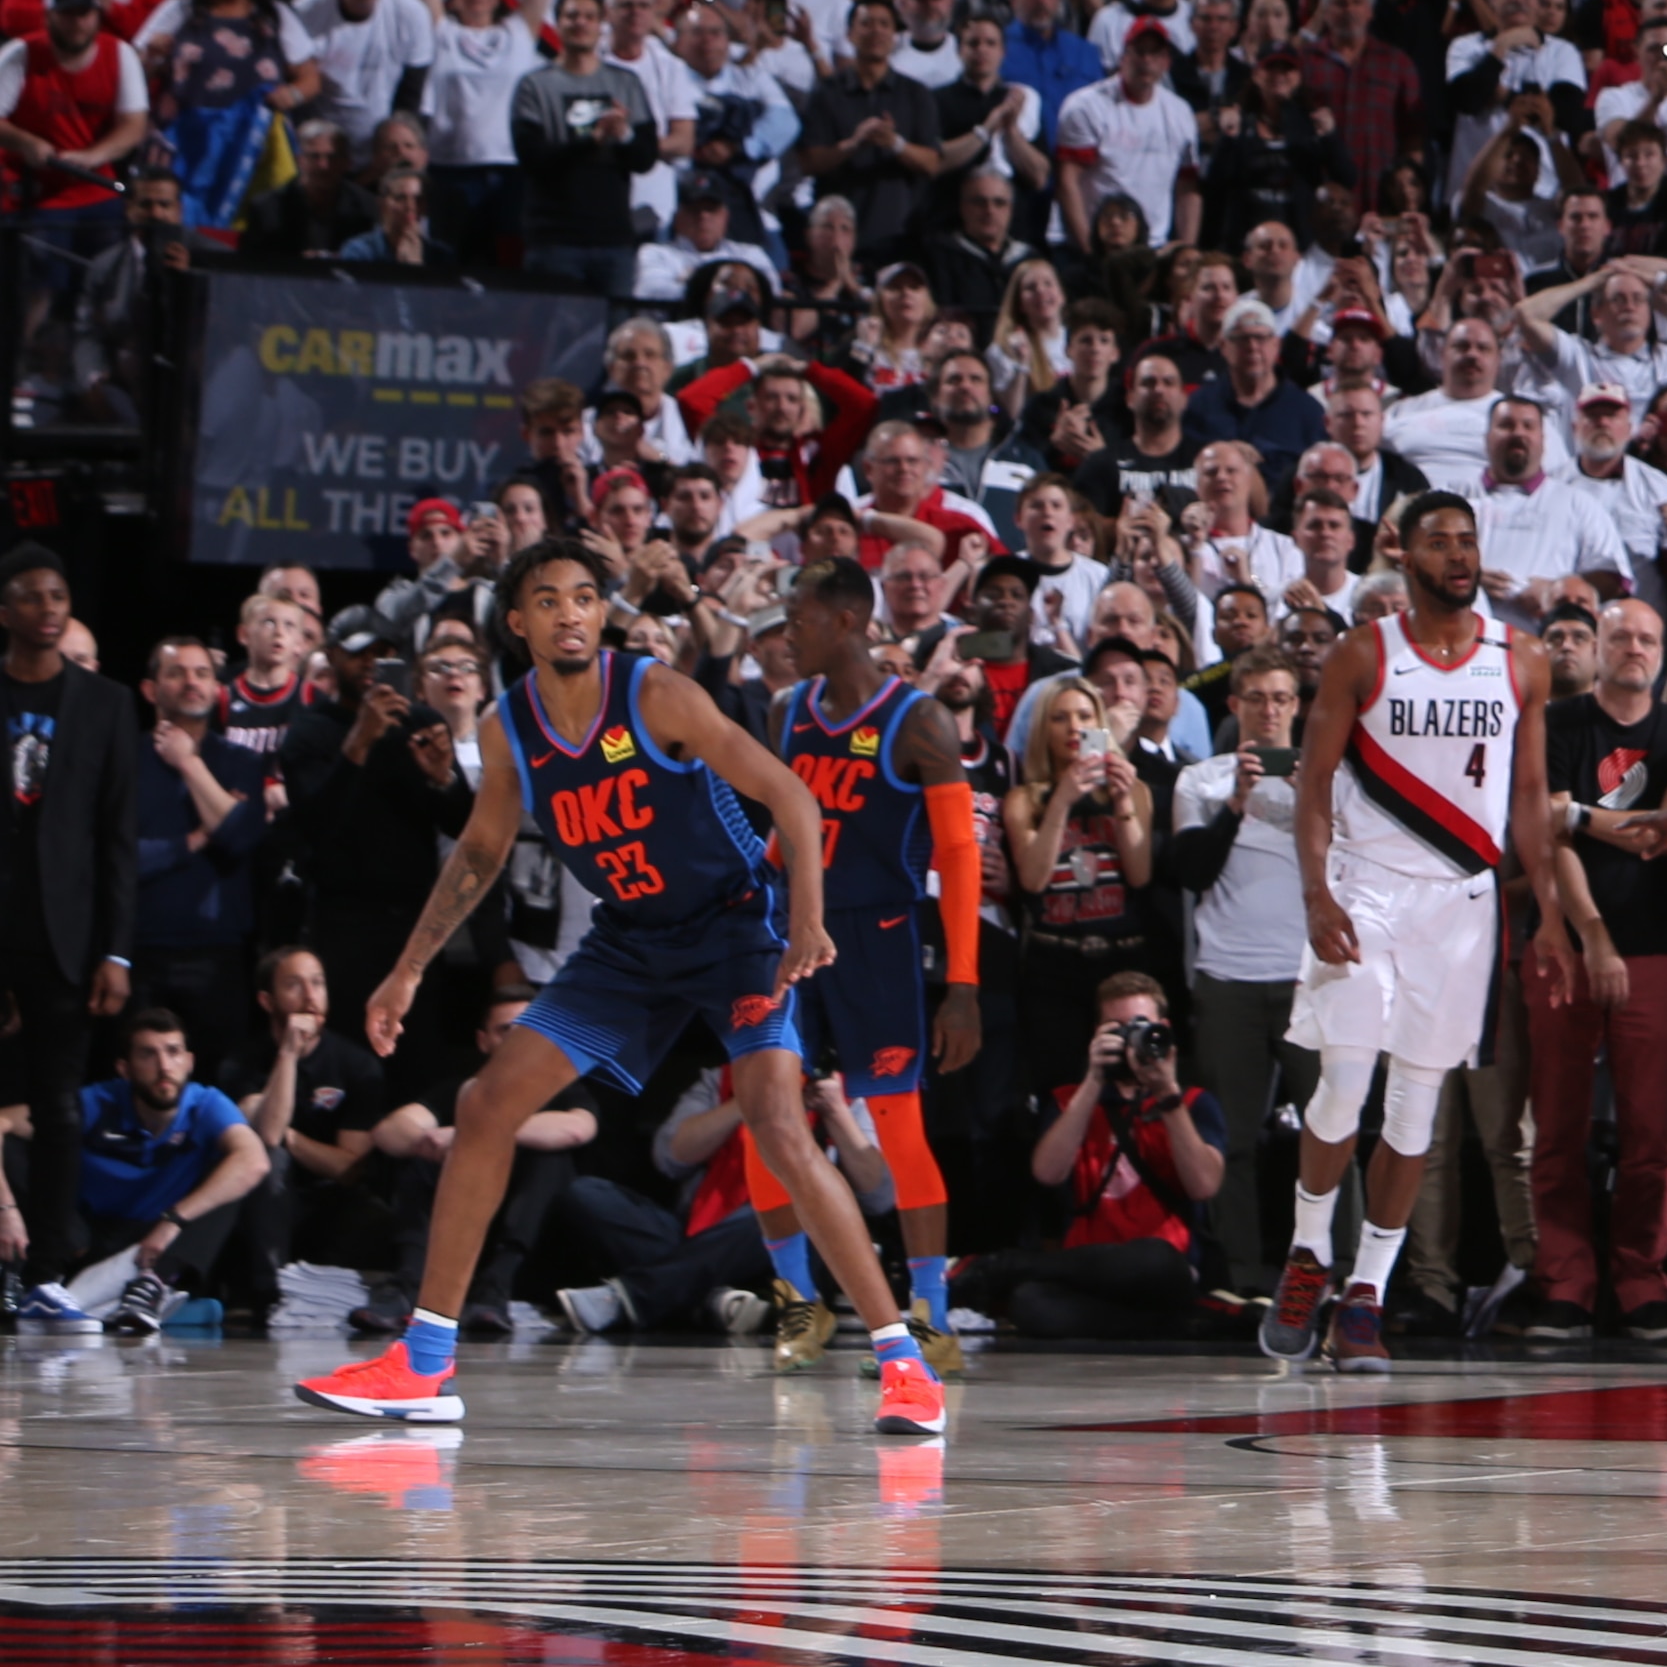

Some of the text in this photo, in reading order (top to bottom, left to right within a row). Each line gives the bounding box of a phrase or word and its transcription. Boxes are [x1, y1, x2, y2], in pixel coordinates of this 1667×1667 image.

[259, 324, 514, 388] CARmax
[302, 432, 502, 484] WE BUY
[217, 485, 309, 530] ALL
[1387, 698, 1505, 737] BLAZERS
[1464, 743, 1487, 788] 4
[551, 767, 656, 847] OKC
[595, 840, 662, 900] 23
